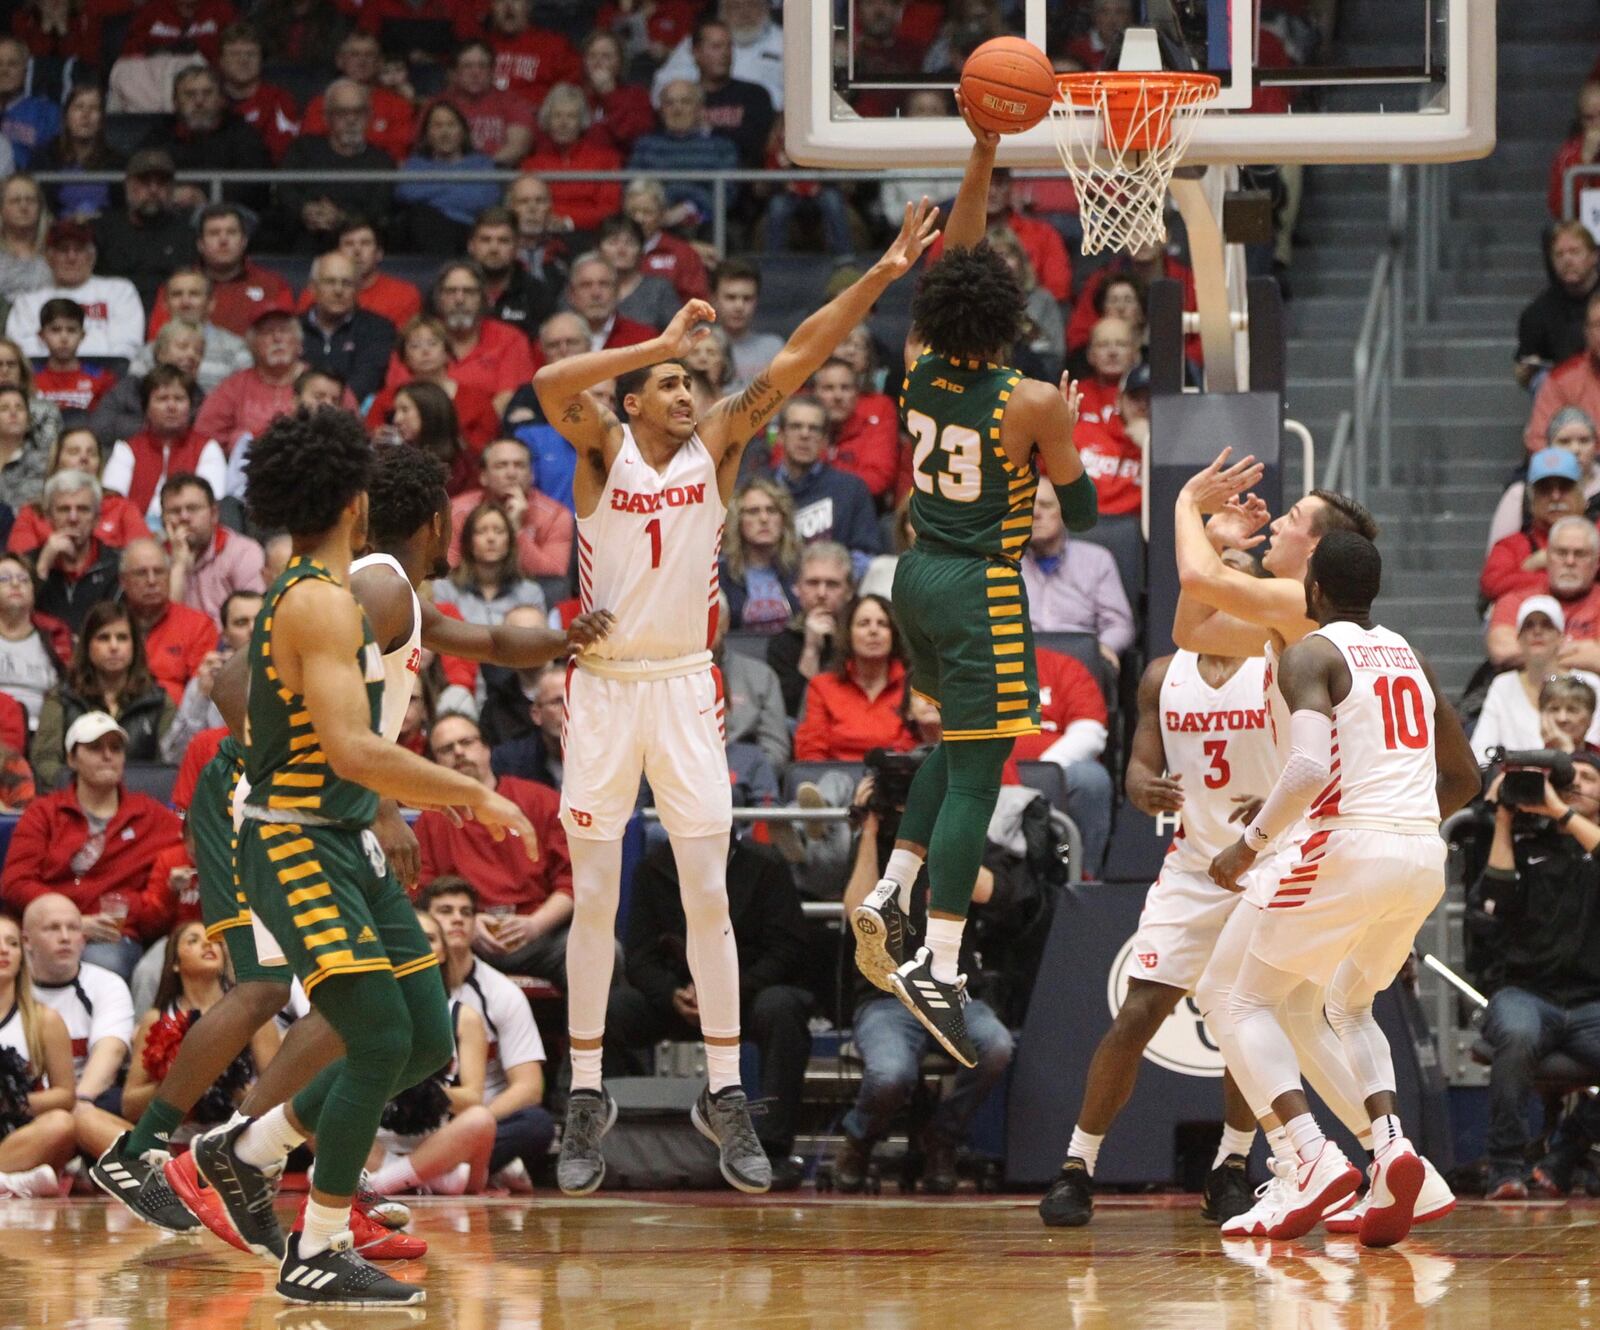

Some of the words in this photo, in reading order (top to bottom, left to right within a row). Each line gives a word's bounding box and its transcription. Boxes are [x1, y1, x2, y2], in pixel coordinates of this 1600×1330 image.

[907, 408, 982, 503] 23
[645, 518, 661, 569] 1
[1166, 709, 1265, 733] DAYTON
[1373, 676, 1428, 750] 10
[1203, 739, 1231, 790] 3
